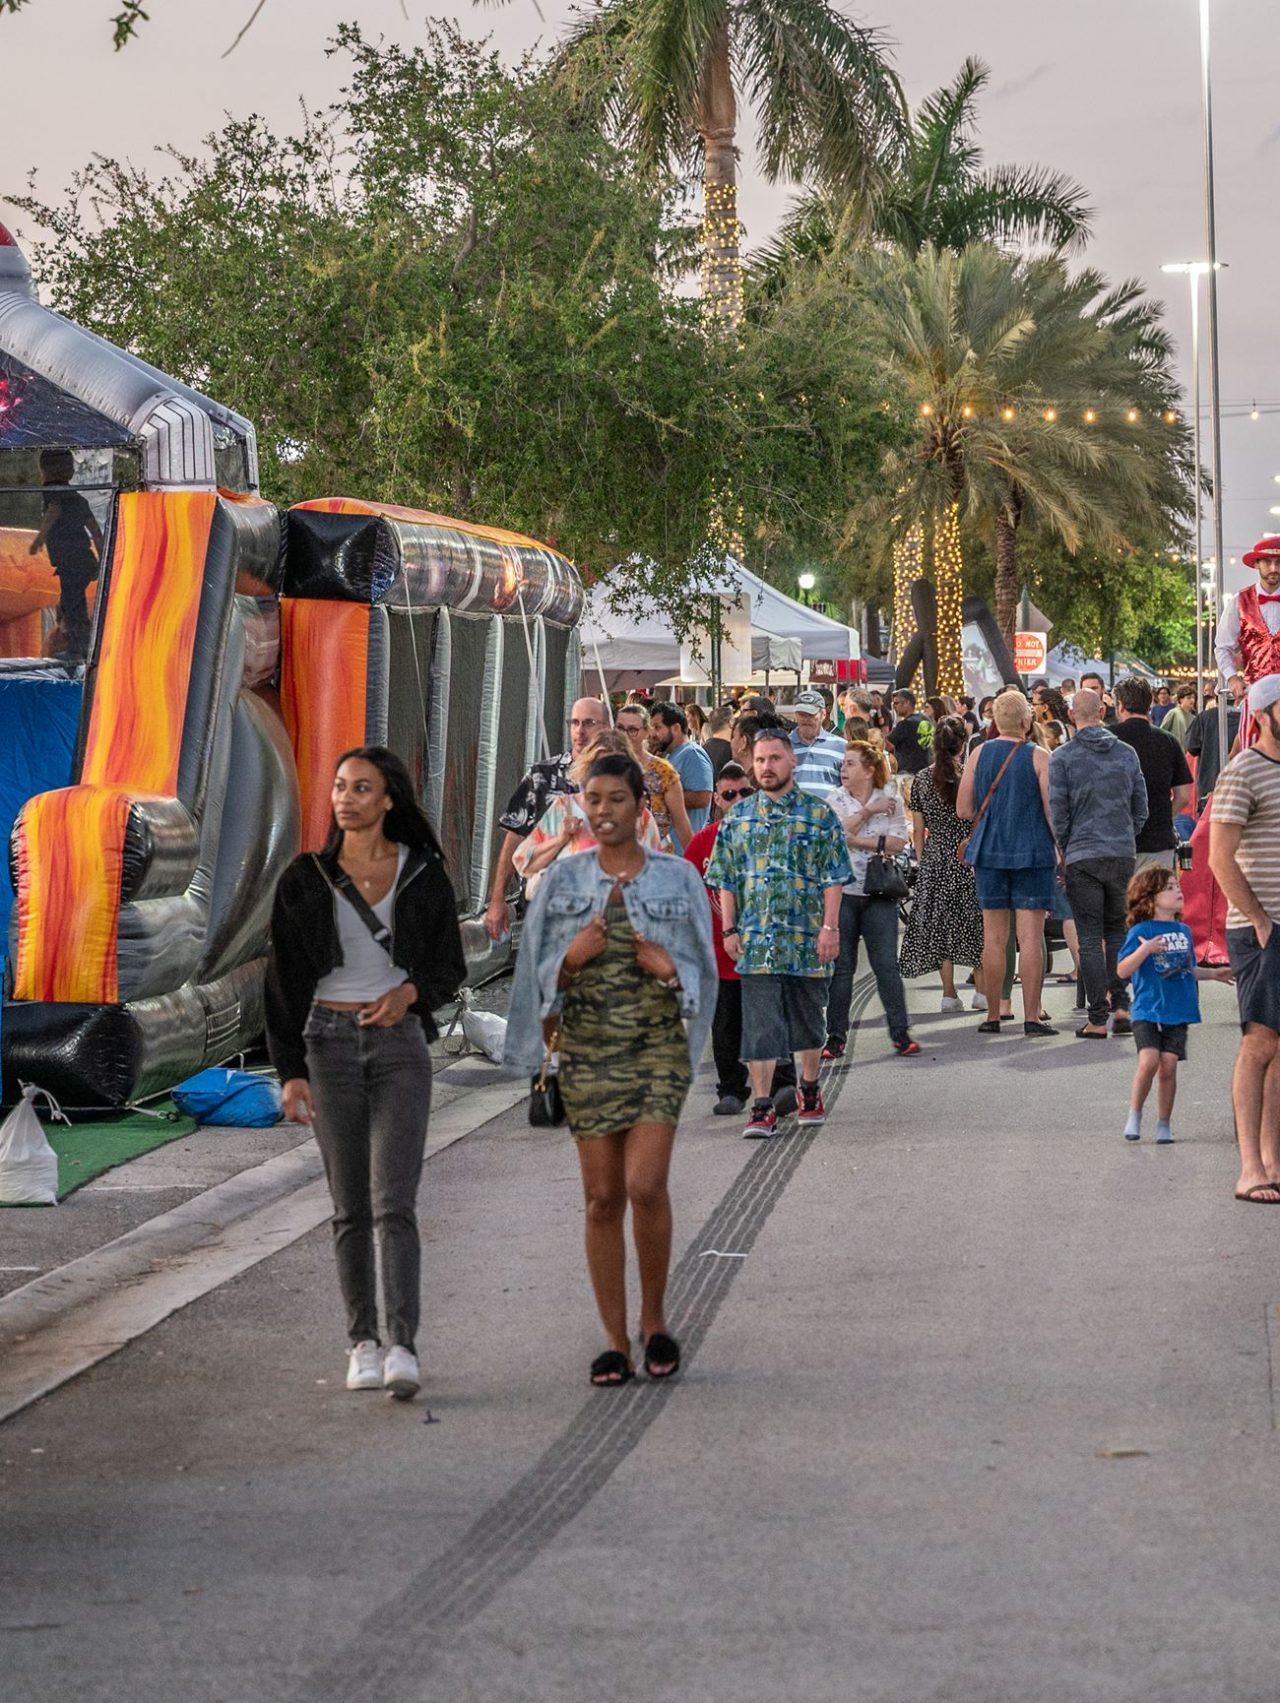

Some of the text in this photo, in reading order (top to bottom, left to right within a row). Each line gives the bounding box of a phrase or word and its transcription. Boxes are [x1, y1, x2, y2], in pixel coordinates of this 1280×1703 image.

[1025, 640, 1039, 648] NOT
[1162, 931, 1187, 942] TAR
[1164, 940, 1188, 951] ARS
